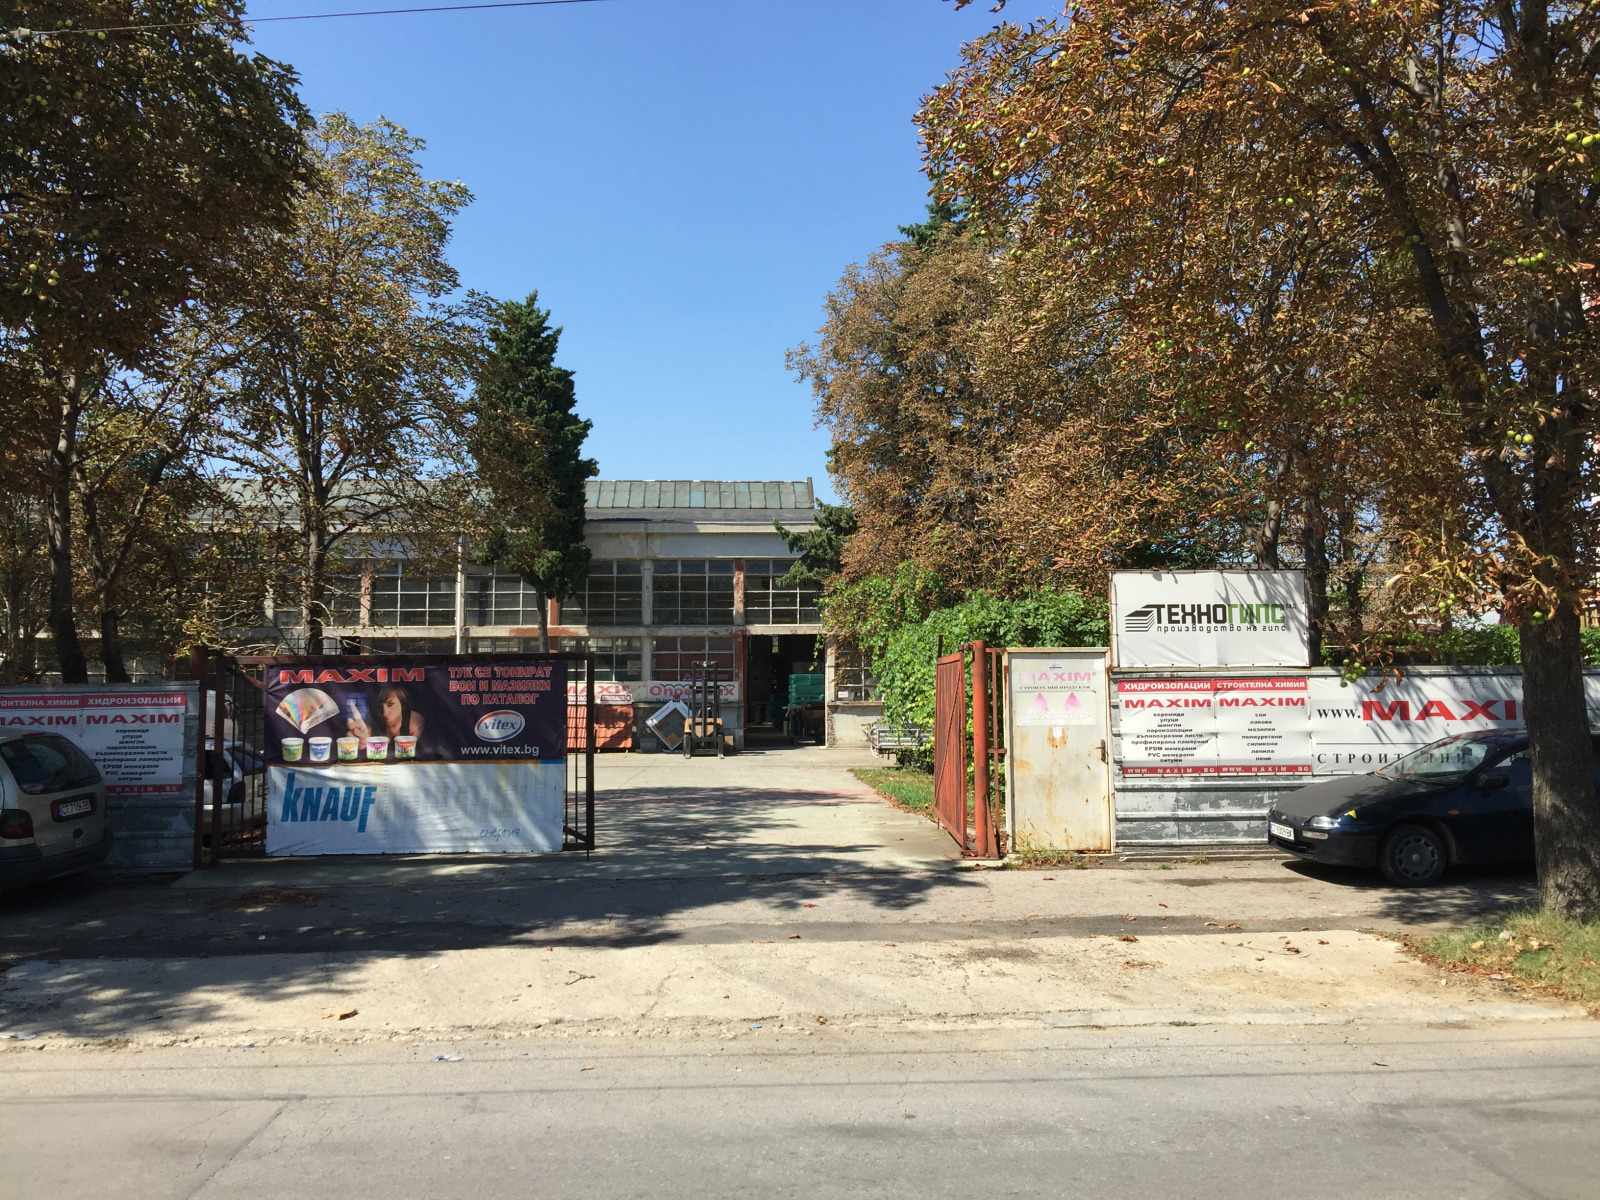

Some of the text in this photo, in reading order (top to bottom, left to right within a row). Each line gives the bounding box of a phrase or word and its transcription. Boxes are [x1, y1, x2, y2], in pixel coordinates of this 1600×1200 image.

[1153, 604, 1284, 624] ТЕХНОГИПС
[1157, 624, 1241, 633] производство
[280, 668, 425, 684] MAXIM
[449, 666, 552, 679] ТУК СЕ ТОНИРАТ
[449, 680, 551, 692] БОИ И МАЗИЛКИ
[1124, 682, 1211, 691] ХИДРОИЗОЛАЦИИ
[1216, 682, 1272, 690] СТРОИТЕЛНА
[88, 697, 181, 706] ХИДРОИЗОЛАЦИИ
[461, 693, 540, 705] ПО КАТАЛОГ
[1124, 698, 1212, 709] MAXIM
[1219, 697, 1306, 707] MAXIM
[86, 714, 180, 725] MAXIM
[484, 718, 518, 731] vitex
[461, 745, 540, 756] www.vitex.bg
